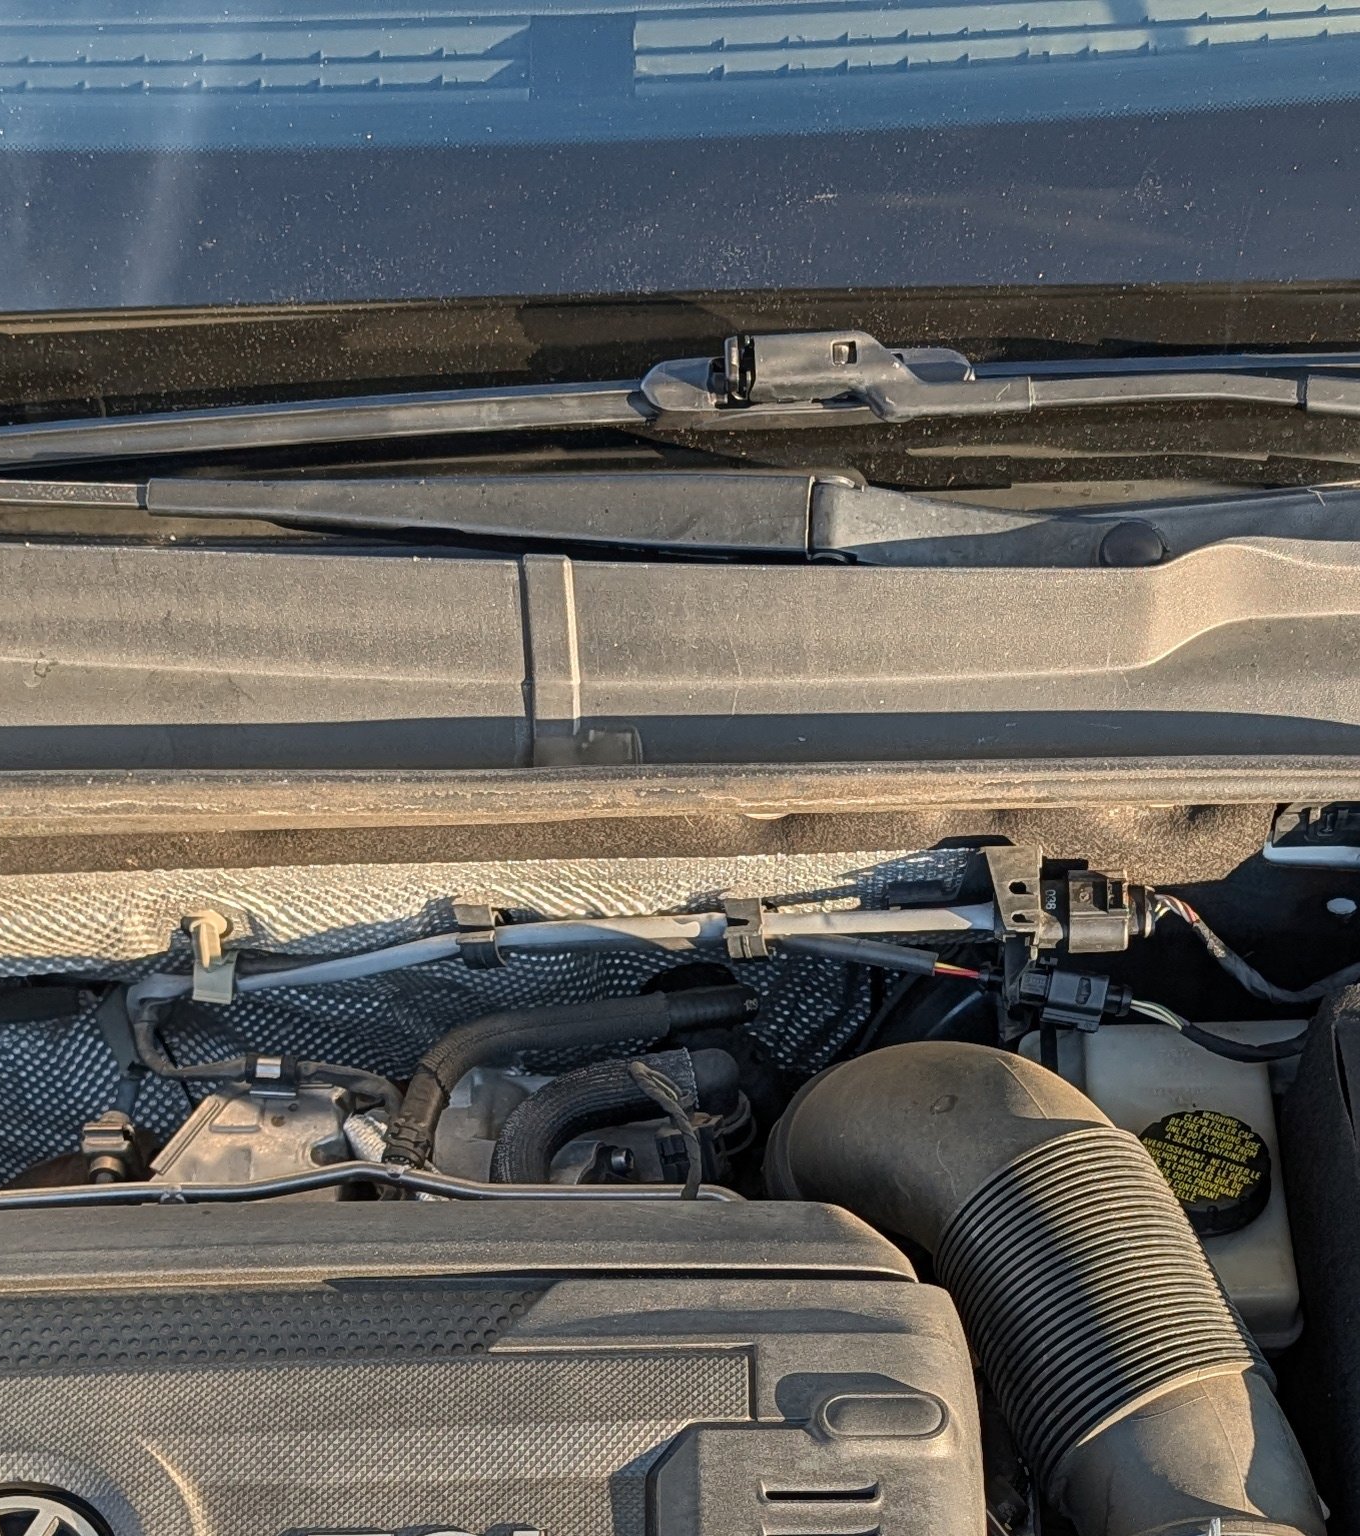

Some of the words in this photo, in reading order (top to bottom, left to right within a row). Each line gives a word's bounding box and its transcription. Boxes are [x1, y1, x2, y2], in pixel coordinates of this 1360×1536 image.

[1165, 1124, 1186, 1135] ONLY
[1187, 1130, 1203, 1140] DOT
[1210, 1137, 1233, 1150] FLUID
[1234, 1144, 1258, 1158] FROM
[1169, 1117, 1199, 1131] BEFORE
[1245, 1141, 1260, 1150] USE
[1184, 1114, 1209, 1126] CLEAN
[1210, 1121, 1239, 1135] FILLER
[1238, 1130, 1254, 1140] CAP
